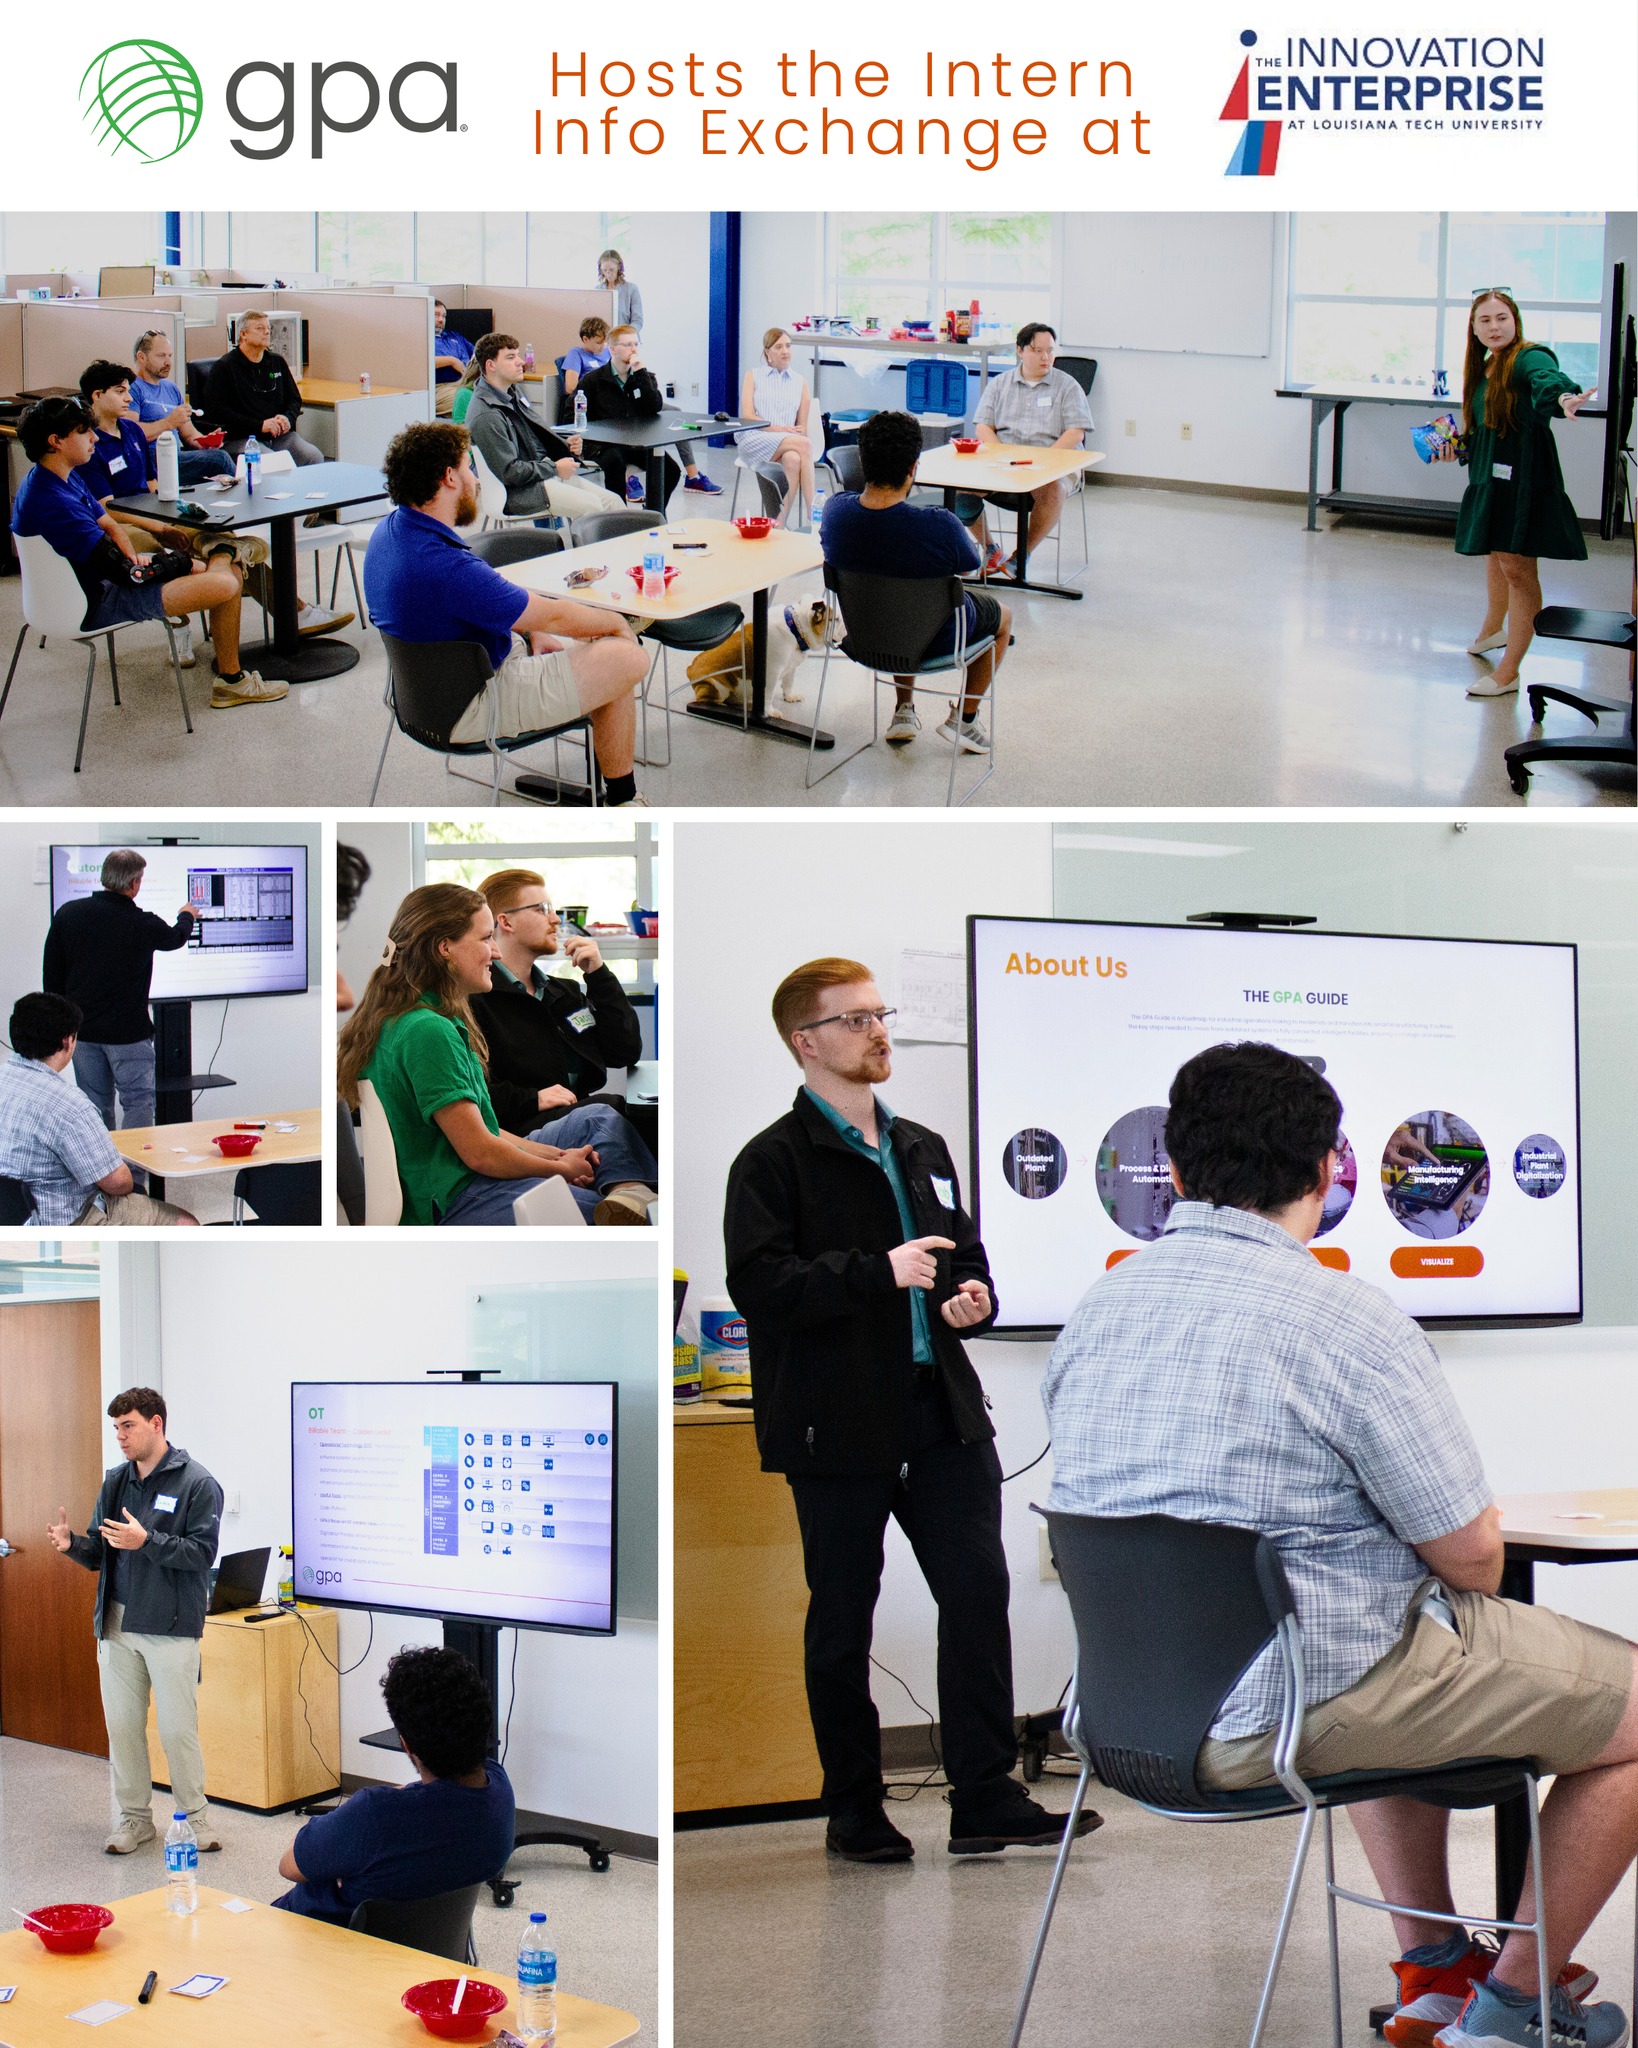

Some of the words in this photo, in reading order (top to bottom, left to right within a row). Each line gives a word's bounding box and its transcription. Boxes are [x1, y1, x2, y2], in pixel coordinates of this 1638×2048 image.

[1004, 952, 1089, 977] About
[1096, 956, 1128, 979] Us
[1243, 989, 1270, 1003] THE
[1273, 991, 1303, 1004] GPA
[1306, 992, 1349, 1006] GUIDE
[1016, 1154, 1054, 1163] Outdated
[1522, 1152, 1557, 1160] Industrial
[1024, 1164, 1046, 1172] Plant
[1119, 1164, 1152, 1173] Process
[1152, 1164, 1160, 1173] &
[1408, 1165, 1464, 1176] Manufacturing
[1530, 1162, 1549, 1170] Plant
[1414, 1175, 1458, 1186] Intelligence
[1516, 1171, 1564, 1181] Digitalization
[1420, 1258, 1455, 1266] VISUALIZE
[308, 1407, 325, 1420] OT
[315, 1569, 342, 1586] gpa
